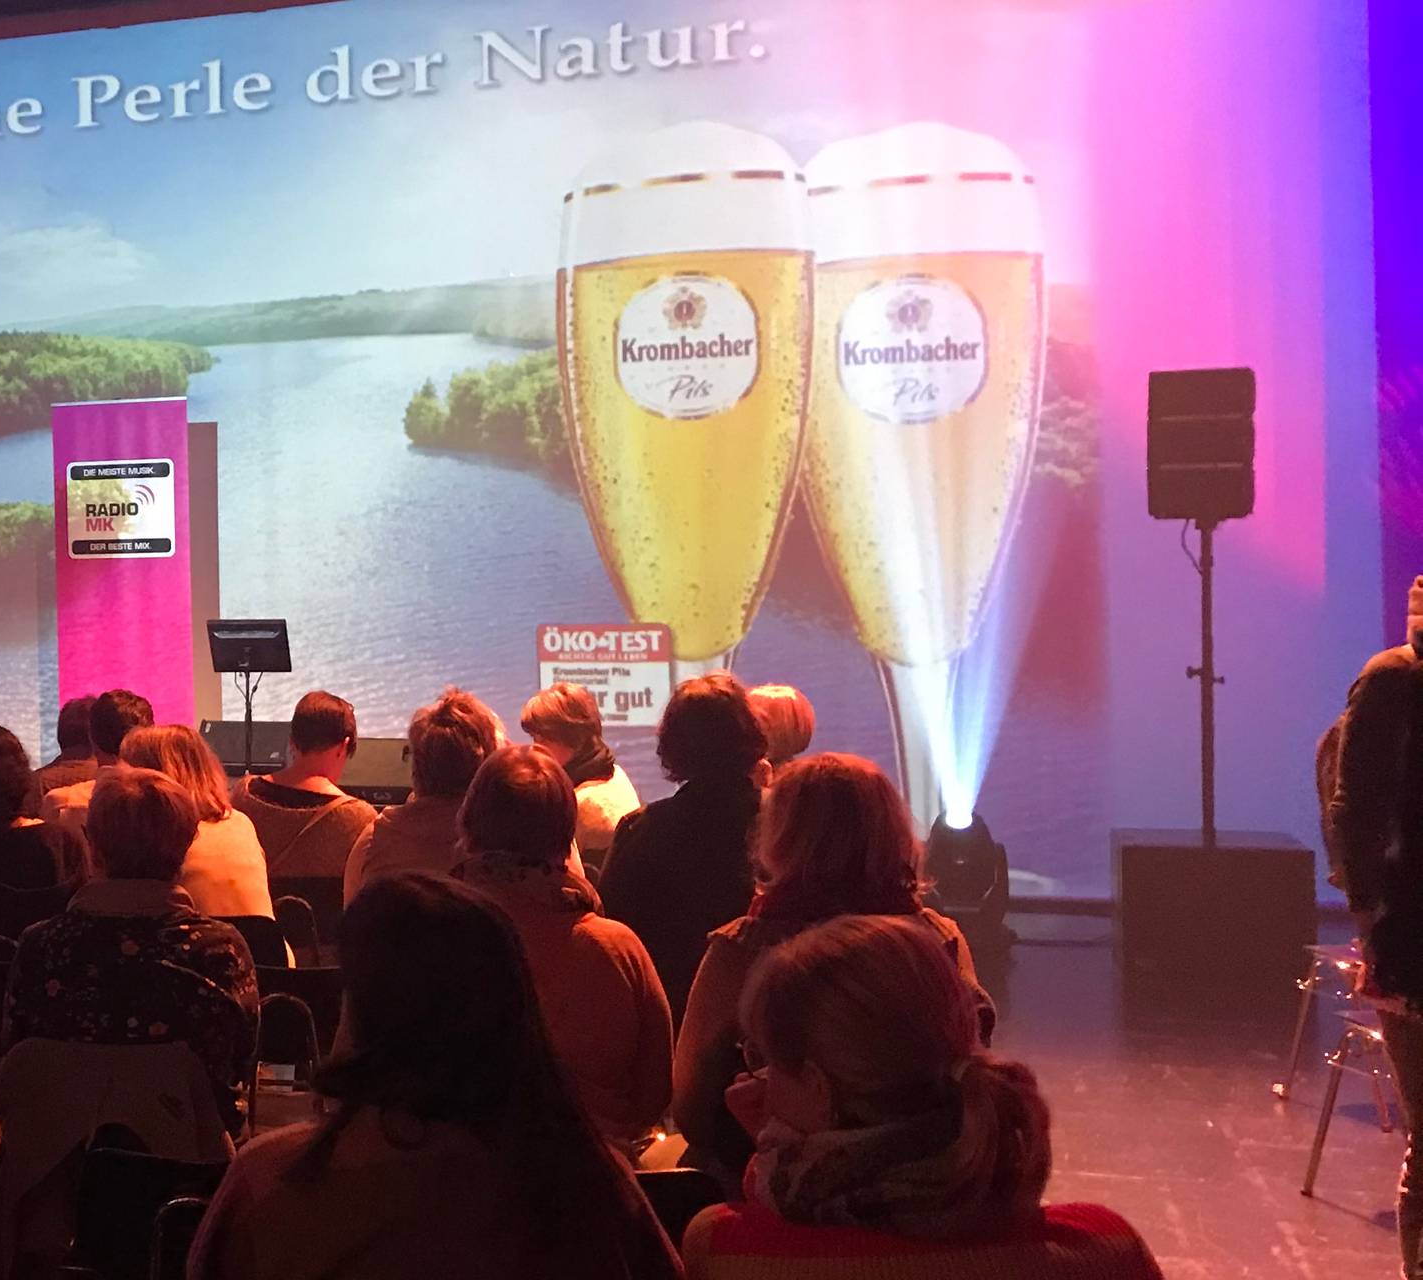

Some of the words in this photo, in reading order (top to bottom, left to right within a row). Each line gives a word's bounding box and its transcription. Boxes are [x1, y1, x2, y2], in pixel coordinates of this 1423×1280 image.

[71, 58, 272, 128] Perle
[305, 44, 443, 103] der
[475, 18, 767, 87] Natur.
[621, 333, 753, 364] Krombacher
[843, 336, 980, 368] Krombacher
[662, 374, 715, 402] Pils
[892, 378, 940, 405] Pils
[83, 468, 96, 477] DIE
[98, 467, 126, 476] MEISTE
[85, 502, 139, 517] RADIO
[85, 518, 115, 532] MK
[90, 543, 106, 551] DER
[108, 542, 132, 551] BESTE
[612, 668, 631, 676] Pils
[615, 687, 653, 711] gut
